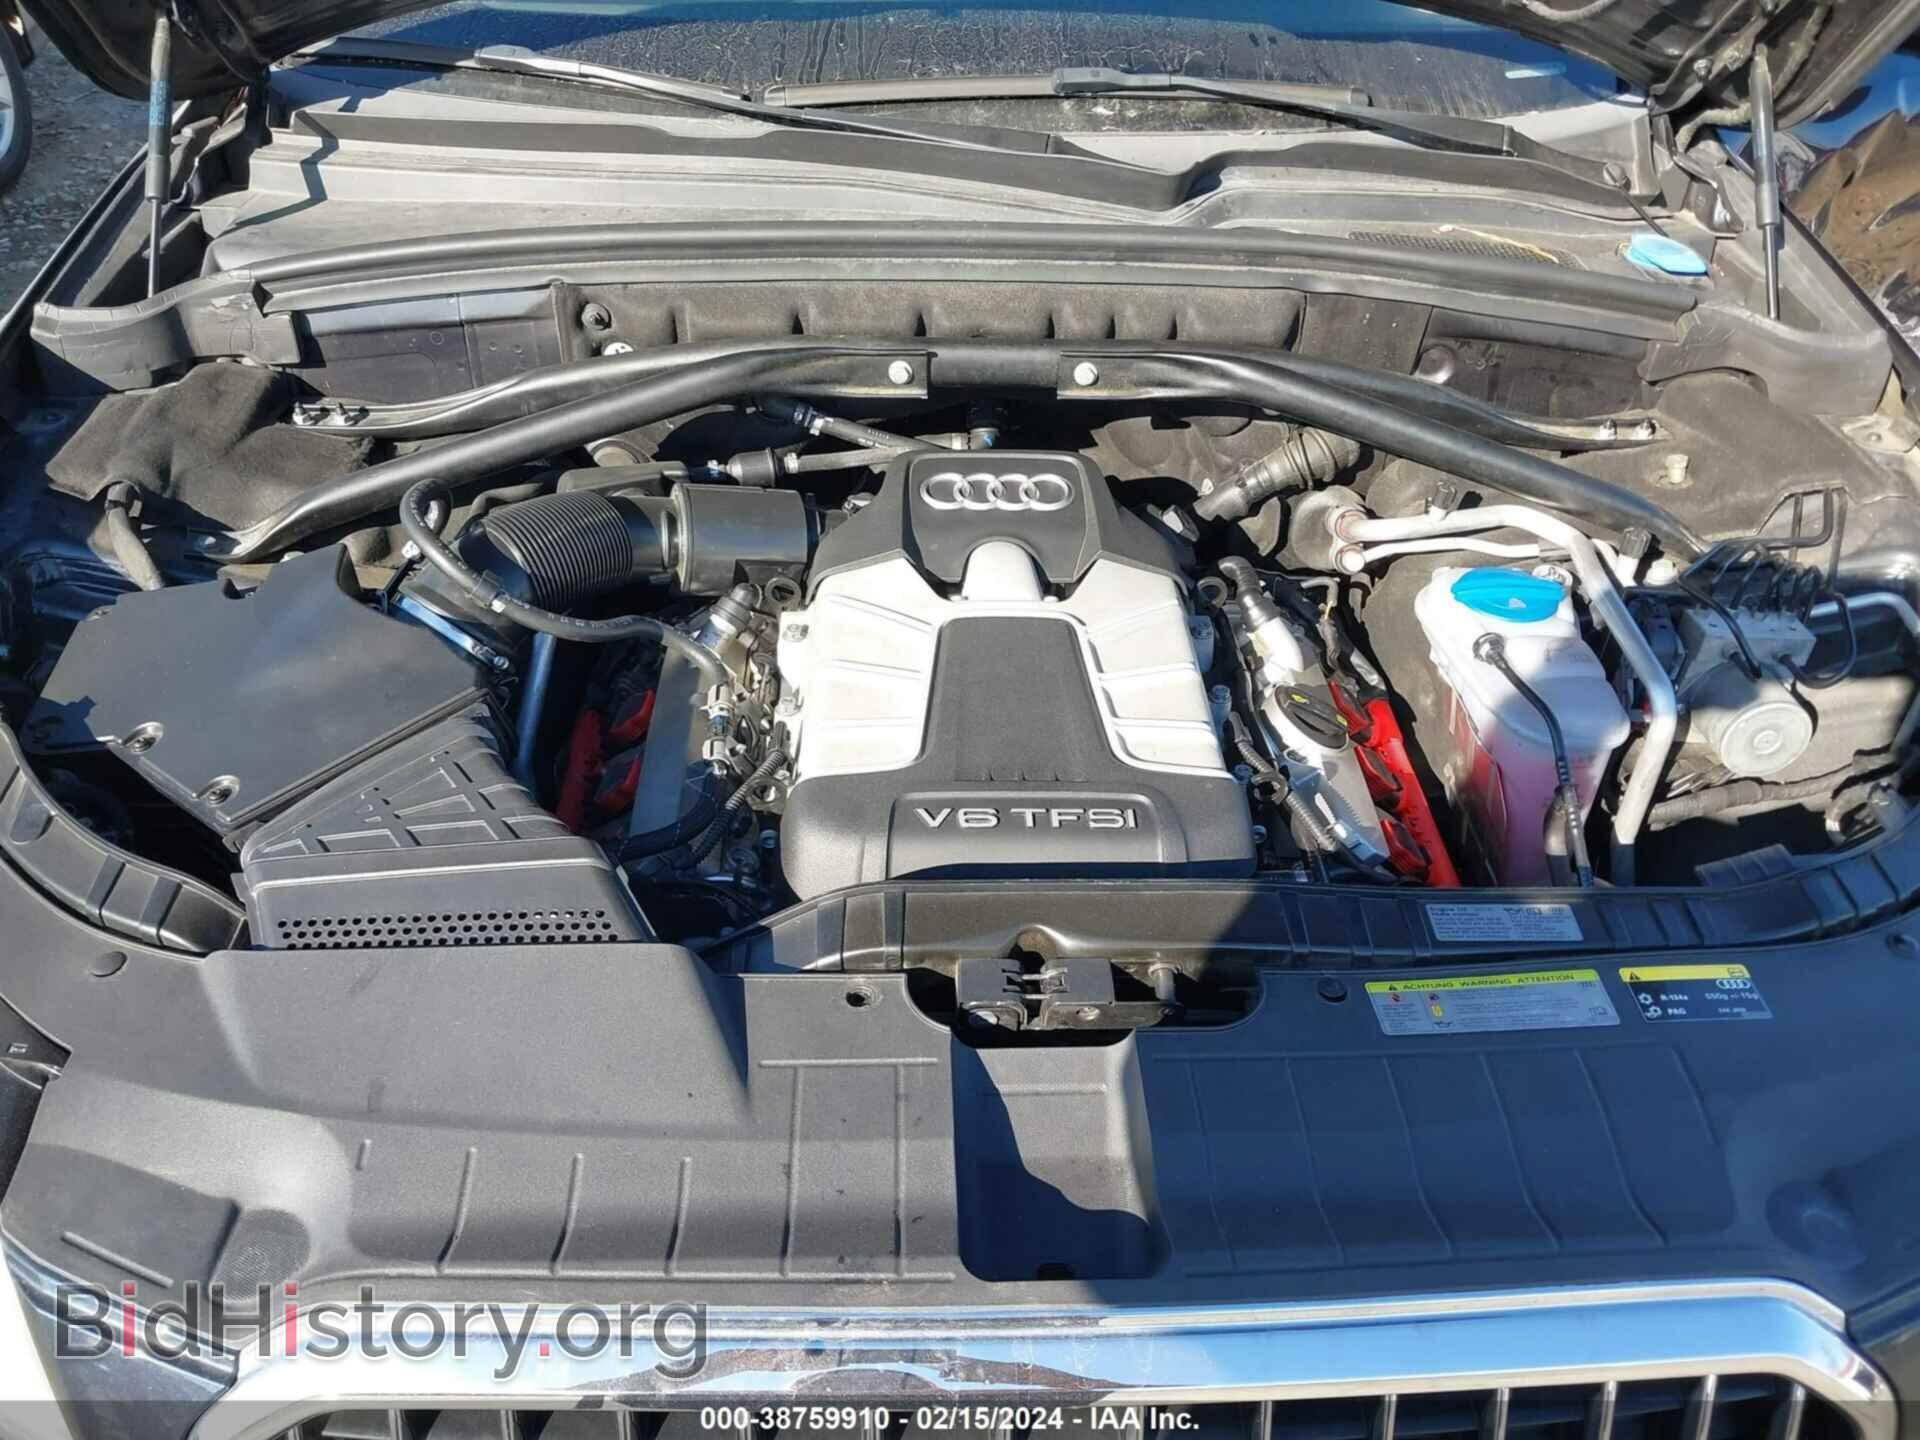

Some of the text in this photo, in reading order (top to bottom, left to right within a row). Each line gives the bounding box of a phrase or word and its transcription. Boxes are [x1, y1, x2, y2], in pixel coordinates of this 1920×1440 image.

[915, 807, 1138, 829] V6 TFSI
[1402, 974, 1575, 991] ACHTUNG WARNING ATTENTION
